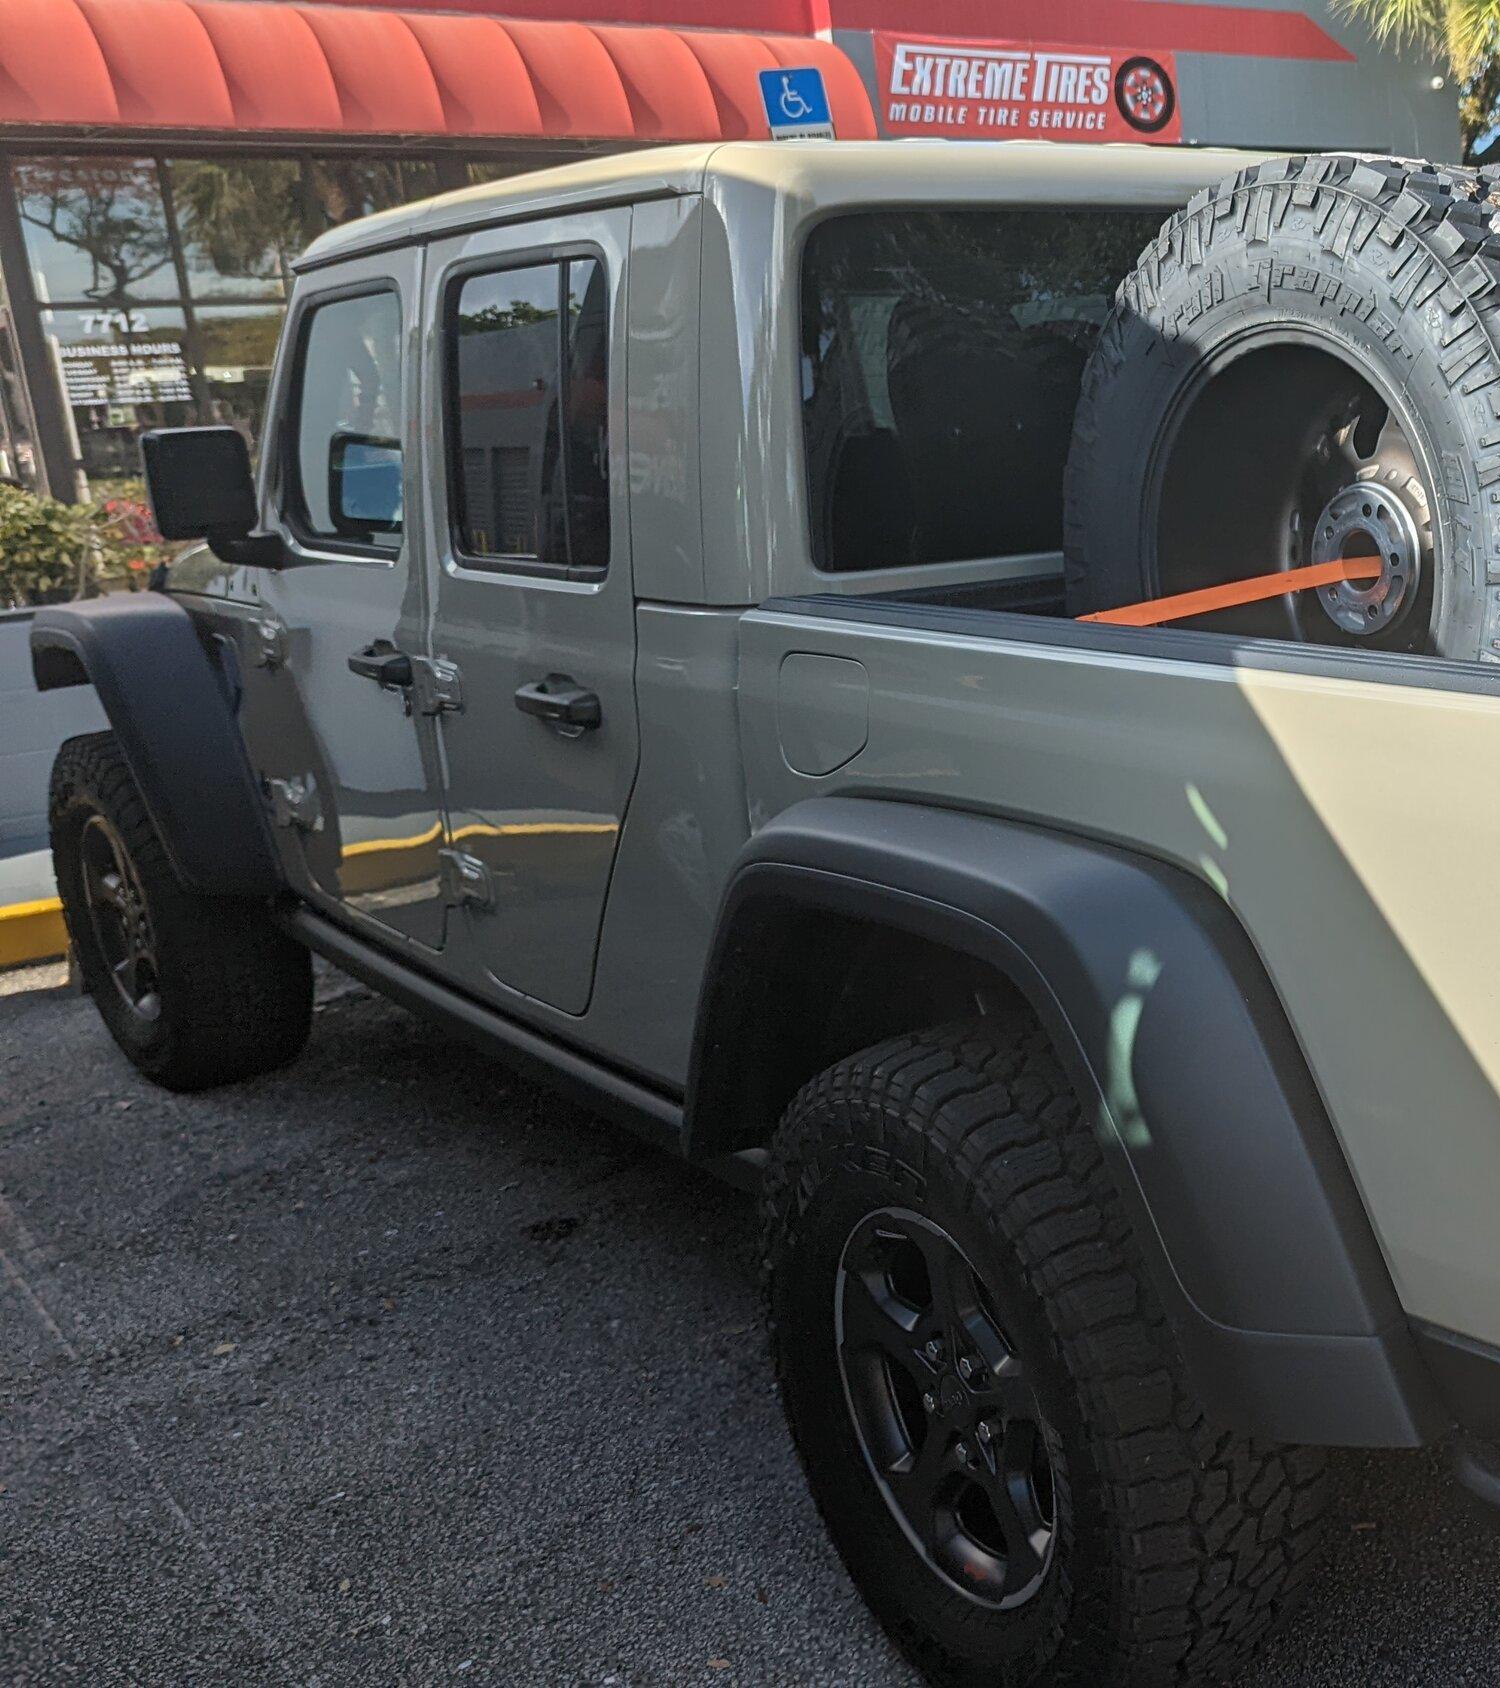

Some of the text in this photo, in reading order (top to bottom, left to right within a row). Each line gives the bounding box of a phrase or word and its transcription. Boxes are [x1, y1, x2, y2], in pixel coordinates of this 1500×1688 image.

[890, 43, 1112, 105] EXTREME TIRES
[889, 103, 1107, 130] MOBILE TIRE SERVICE
[79, 312, 149, 334] 7712
[129, 342, 181, 355] HOURS
